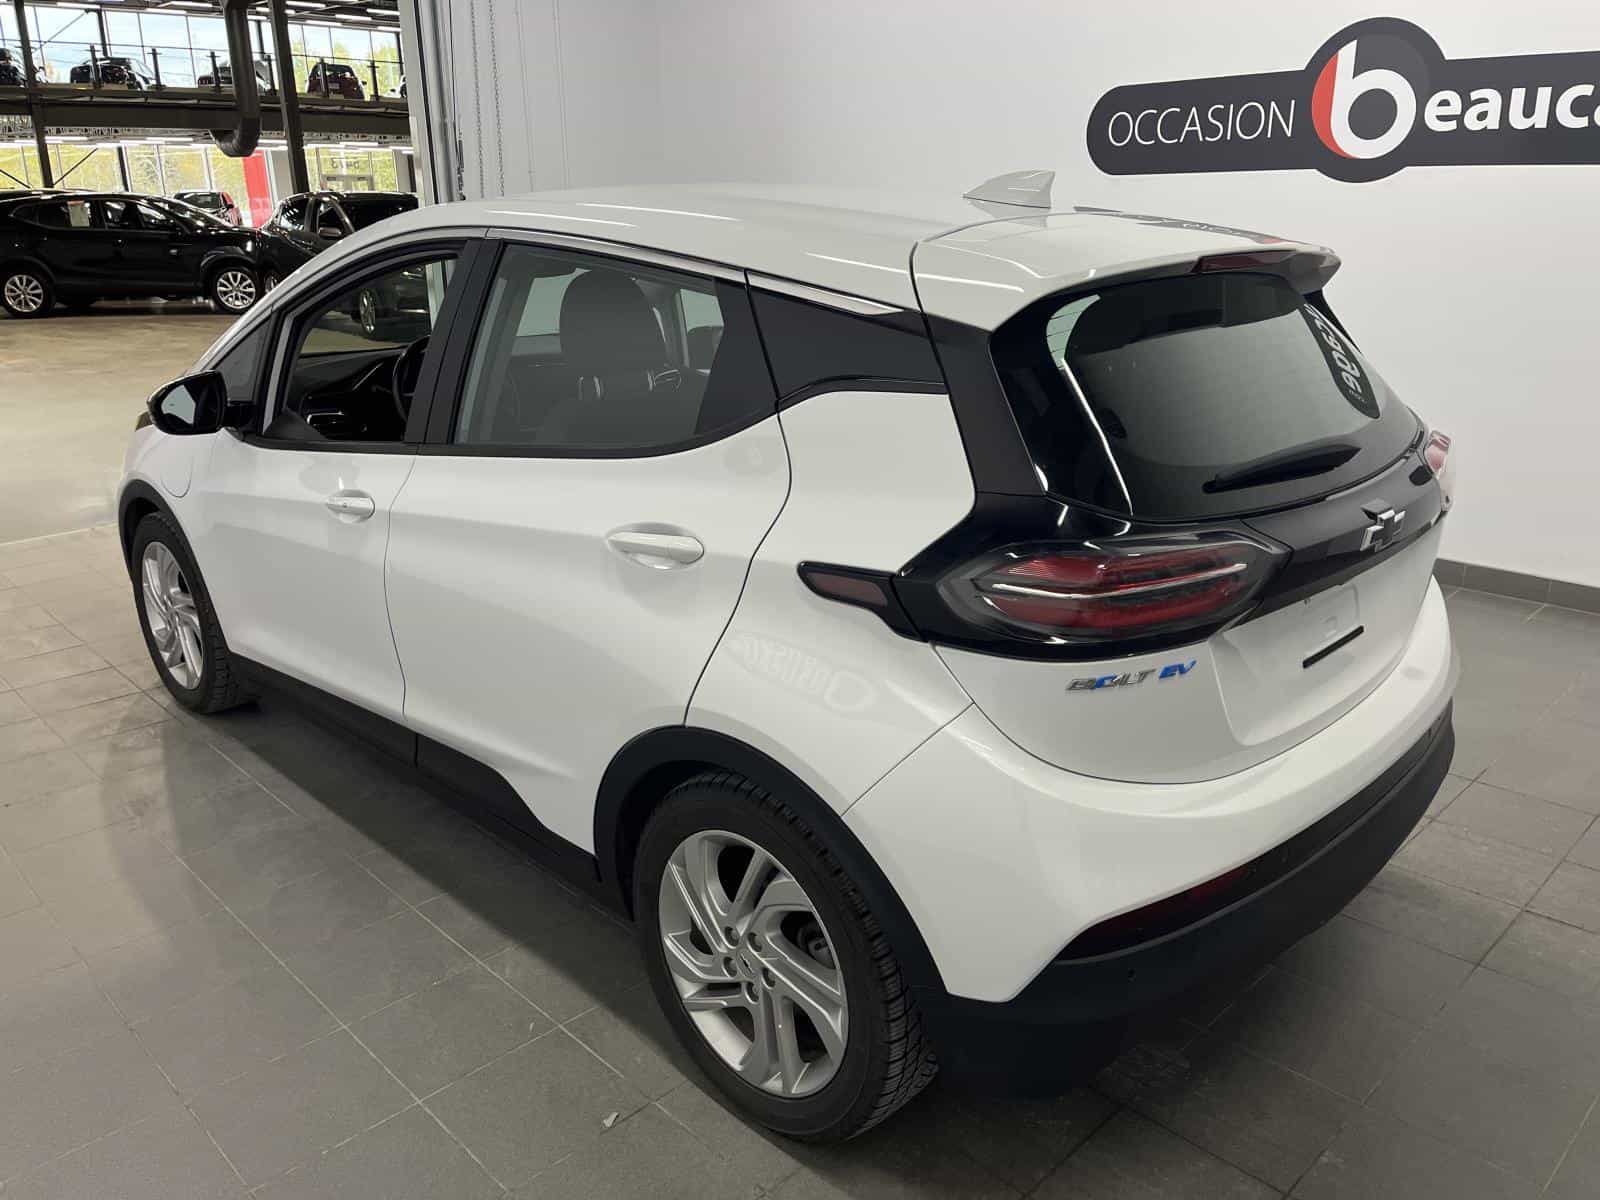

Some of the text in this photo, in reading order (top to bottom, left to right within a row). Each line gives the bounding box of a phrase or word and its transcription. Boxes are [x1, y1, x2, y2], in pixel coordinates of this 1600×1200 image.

[1108, 40, 1600, 160] OCCASION beauc
[1064, 660, 1197, 691] BOLT EV
